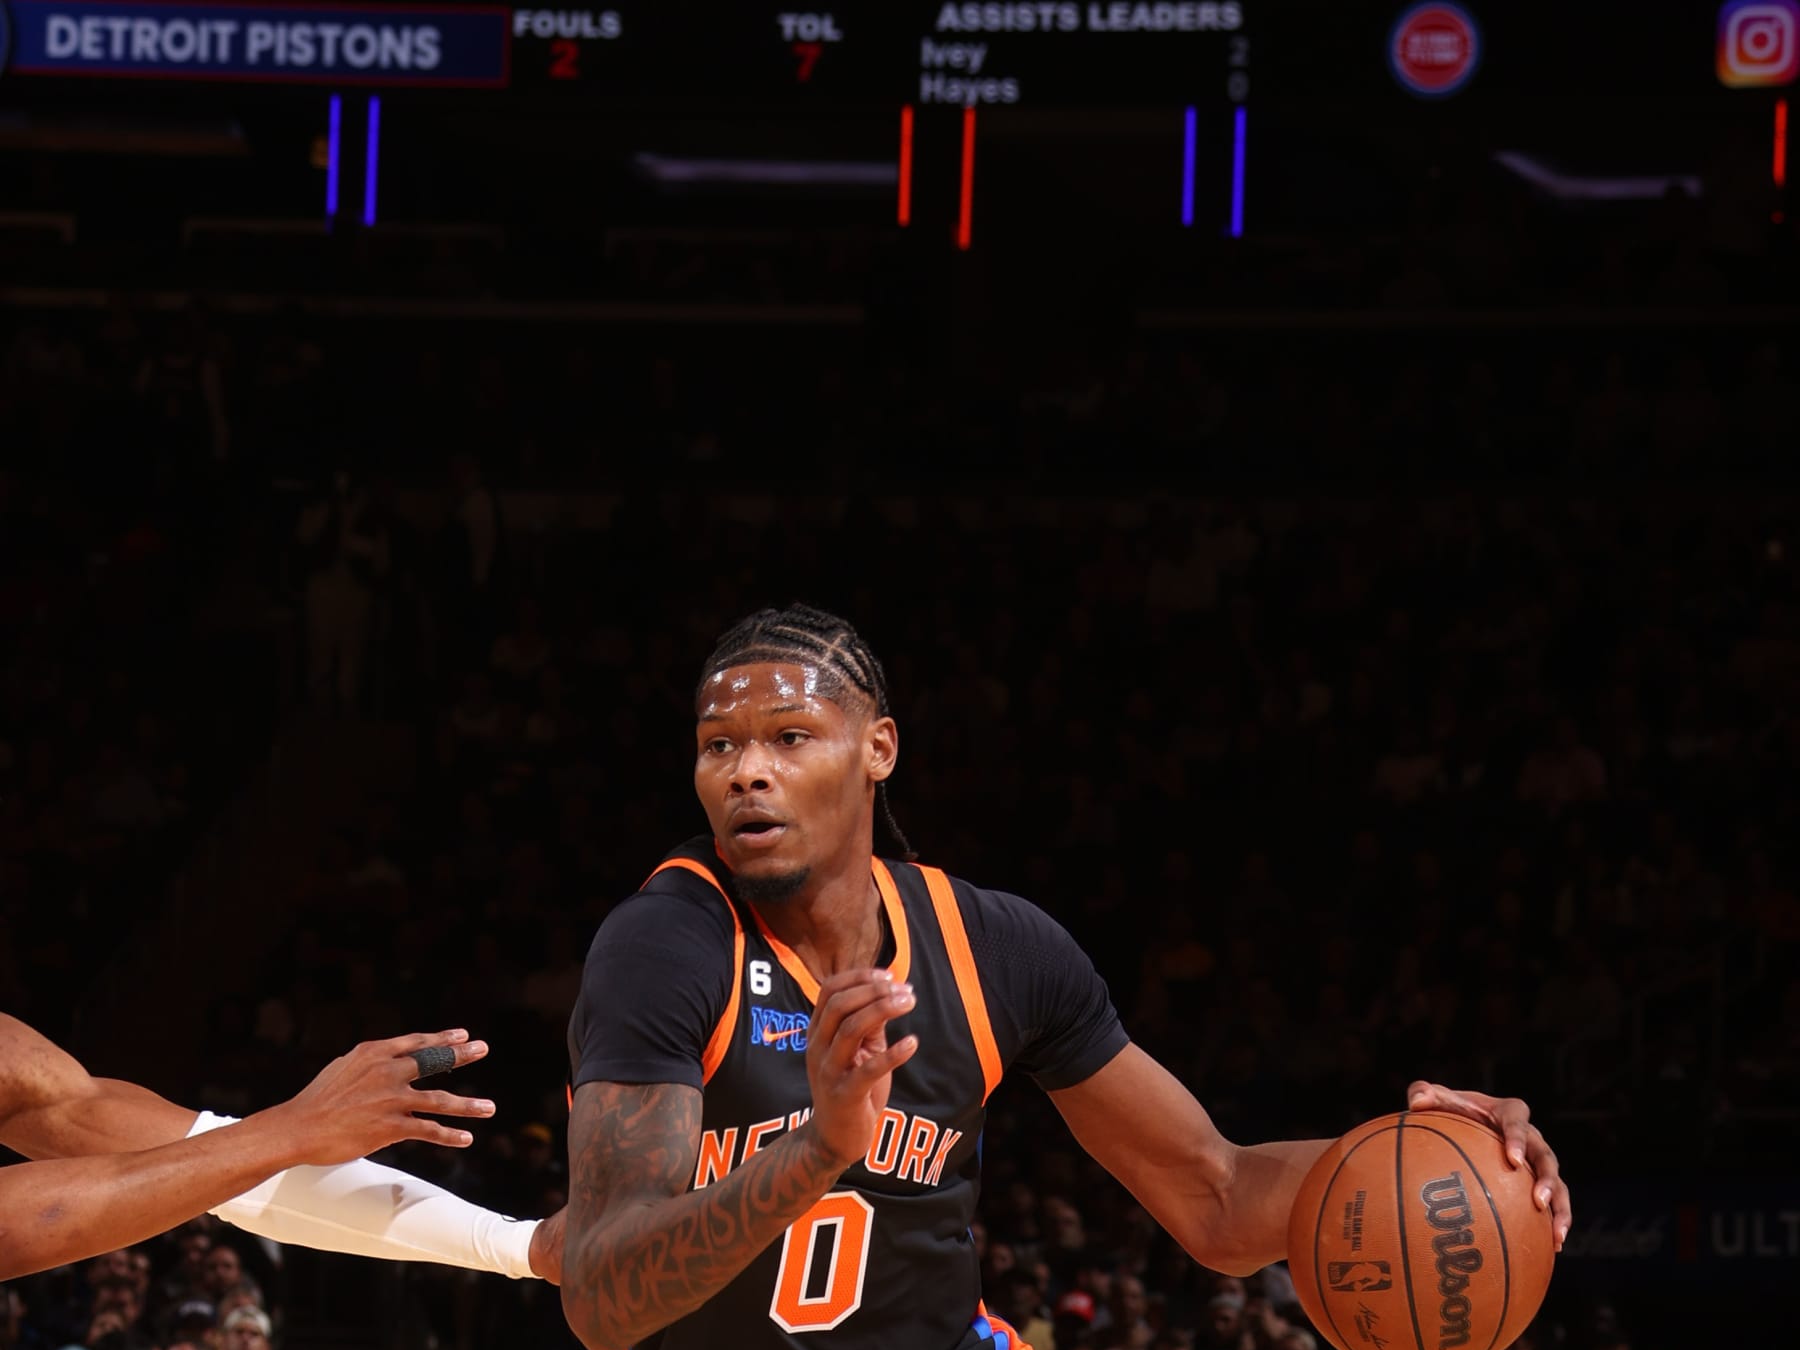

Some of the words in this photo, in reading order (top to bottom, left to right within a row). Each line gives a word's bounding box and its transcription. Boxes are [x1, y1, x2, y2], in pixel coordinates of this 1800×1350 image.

[513, 10, 621, 39] FOULS
[778, 13, 841, 41] TOL
[937, 2, 1079, 31] ASSISTS
[1088, 3, 1242, 31] LEADERS
[45, 15, 237, 61] DETROIT
[246, 22, 440, 68] PISTONS
[921, 38, 987, 72] Ivey
[549, 42, 579, 79] 2
[794, 43, 822, 81] 7
[920, 73, 1020, 107] Hayes
[750, 960, 771, 996] 6
[751, 1006, 811, 1051] NYC
[694, 1107, 814, 1190] NE
[864, 1106, 963, 1187] ORK
[769, 1191, 874, 1334] 0
[1420, 1171, 1483, 1350] Wilson
